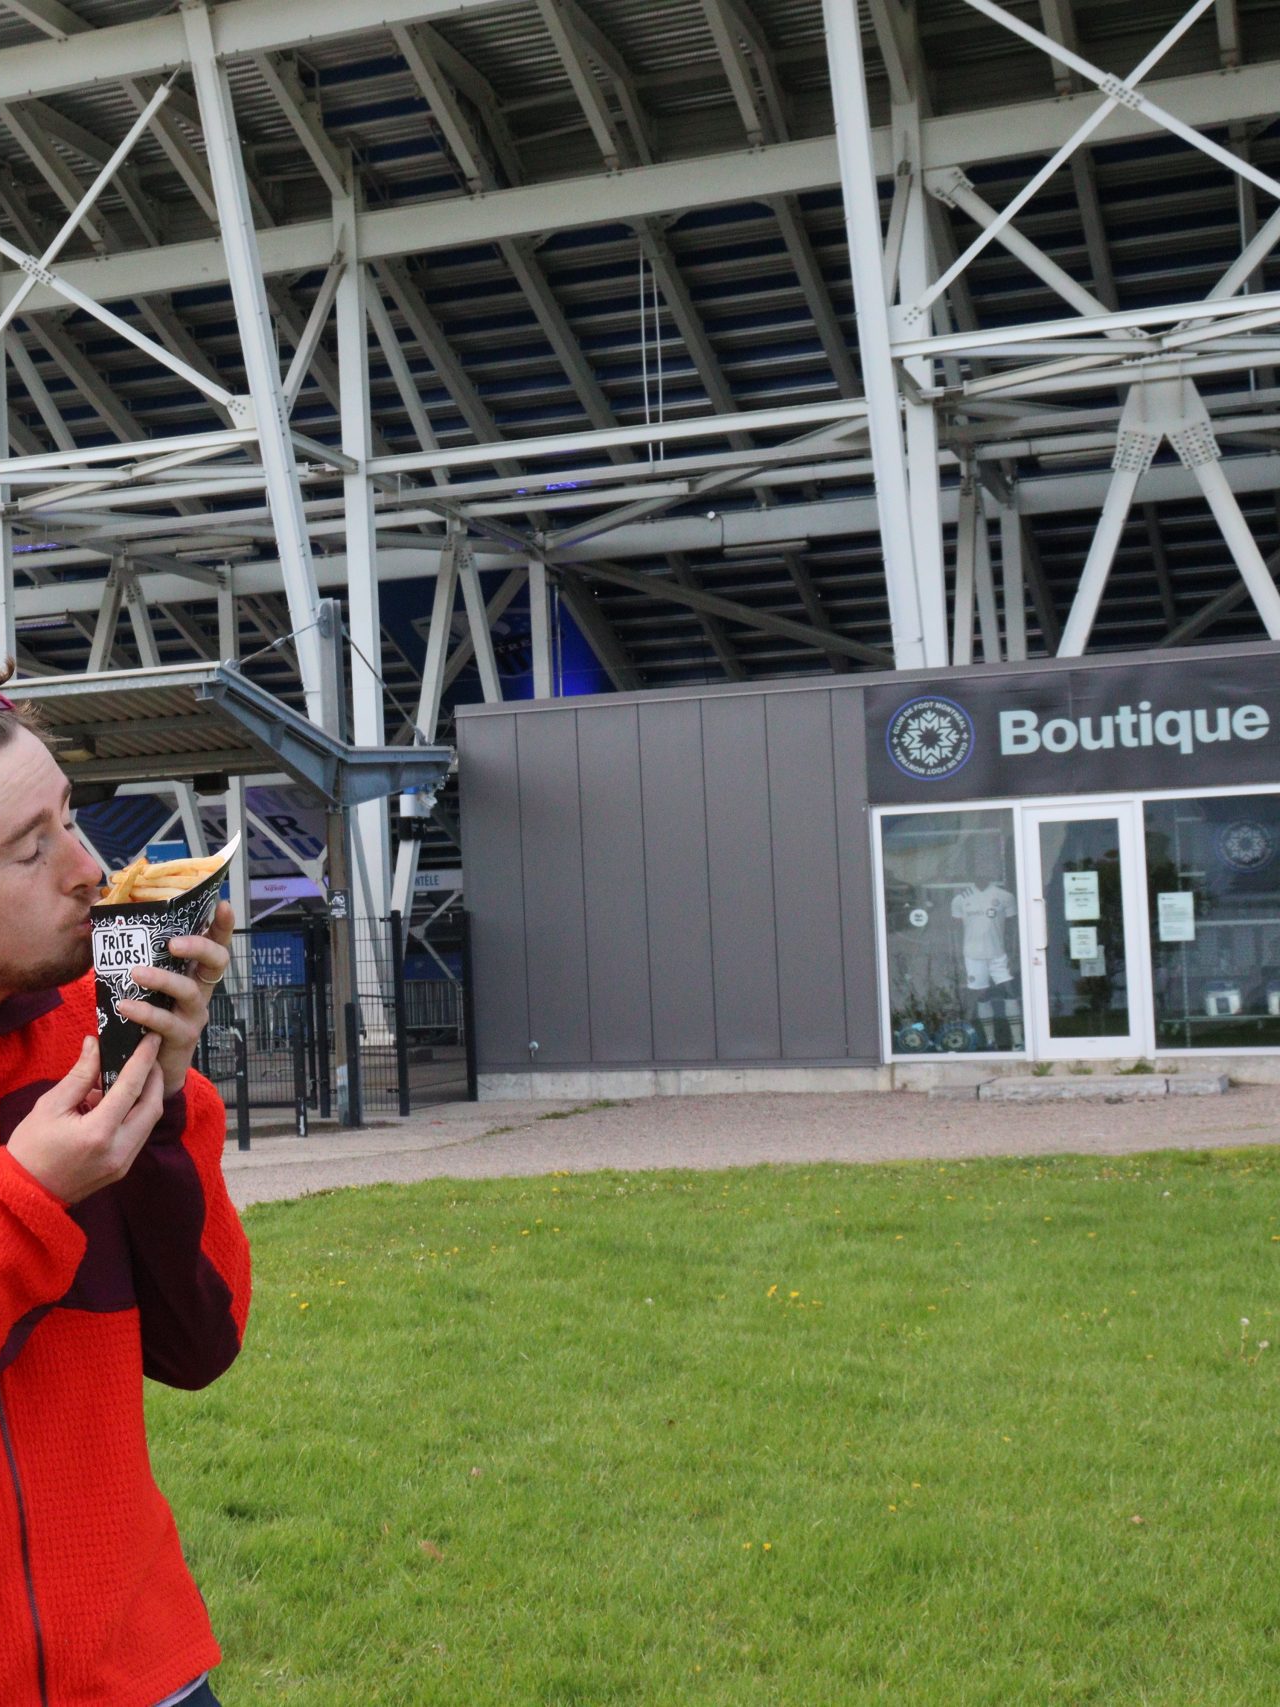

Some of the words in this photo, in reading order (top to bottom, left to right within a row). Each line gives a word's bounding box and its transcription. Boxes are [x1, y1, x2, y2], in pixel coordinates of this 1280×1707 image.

[999, 701, 1269, 755] Boutique
[102, 932, 134, 951] FRITE
[99, 943, 146, 967] ALORS!
